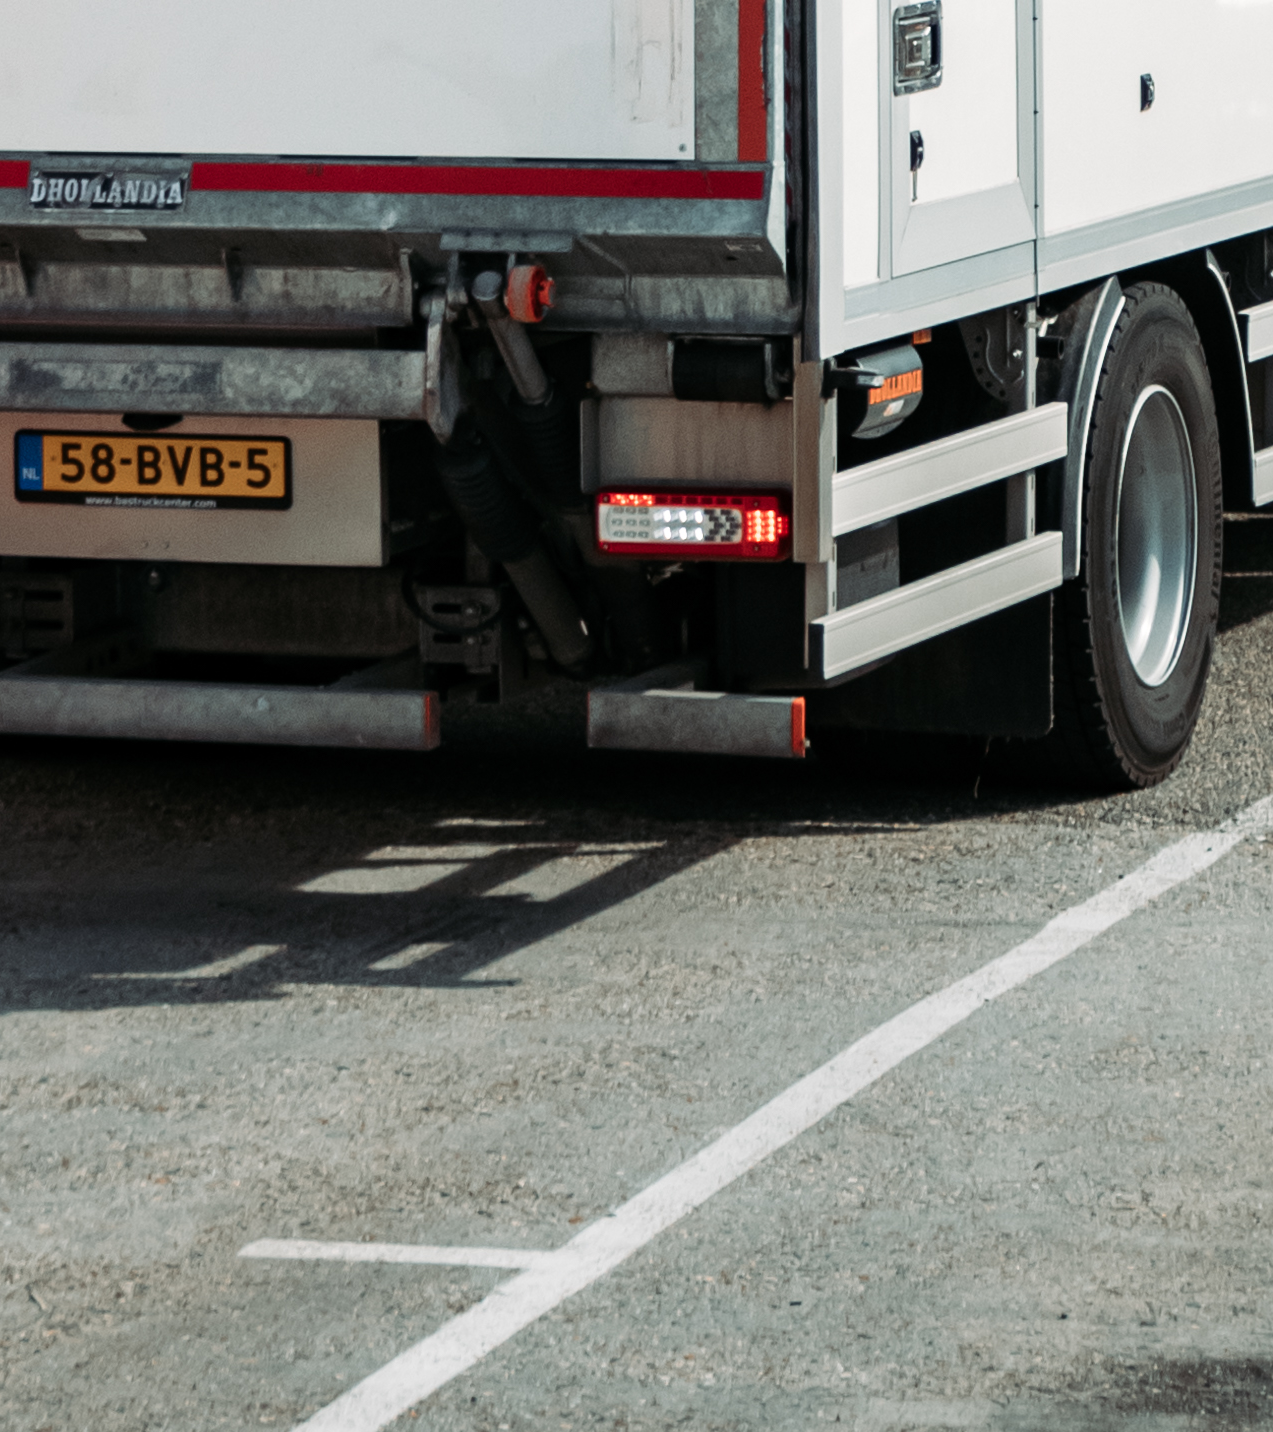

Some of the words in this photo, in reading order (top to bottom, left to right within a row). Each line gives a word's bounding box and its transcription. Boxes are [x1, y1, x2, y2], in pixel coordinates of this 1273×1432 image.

[30, 177, 184, 205] DHOLLANDIA
[22, 467, 41, 481] NL
[59, 441, 273, 489] 58-BVB-5
